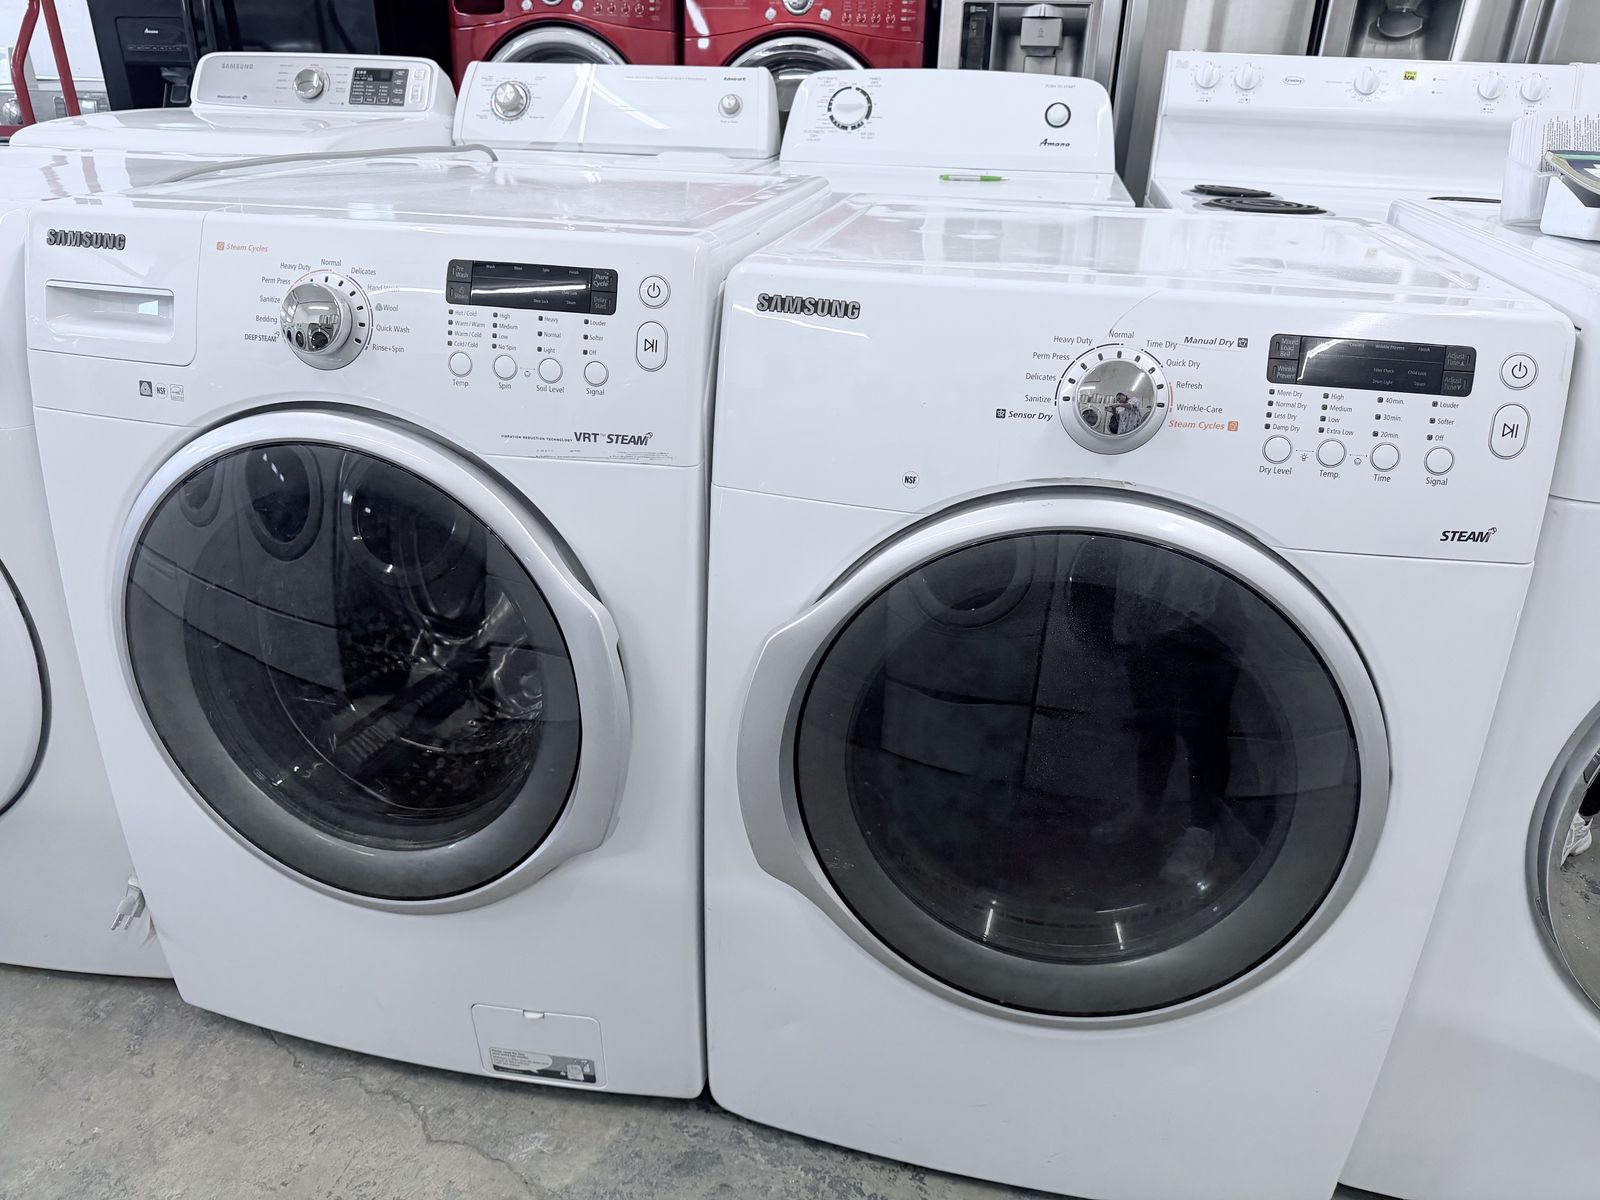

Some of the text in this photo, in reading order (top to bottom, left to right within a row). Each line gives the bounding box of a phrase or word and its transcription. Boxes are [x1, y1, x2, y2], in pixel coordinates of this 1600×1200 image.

[1039, 138, 1071, 147] Amana
[46, 228, 126, 251] SAMSUNG
[226, 243, 268, 253] Steam Cycles
[280, 262, 312, 272] Heavy Duty
[351, 267, 376, 275] Delicates
[262, 276, 275, 284] Perm
[757, 293, 861, 319] SAMSUNG
[256, 315, 278, 324] Bedding
[1109, 331, 1135, 339] Normal
[1053, 336, 1093, 345] Heavy Duty
[1147, 340, 1178, 350] Time Dry
[1184, 336, 1235, 347] Manual Dry
[1166, 359, 1201, 369] Quick Dry
[1026, 372, 1056, 381] Delicates
[498, 382, 511, 390] Spin
[1176, 381, 1203, 390] Refresh
[586, 388, 605, 396] Signal
[1293, 390, 1303, 399] Dry
[1025, 395, 1051, 403] Sanitize
[1331, 393, 1344, 401] High
[1176, 404, 1223, 414] Wrinkle-Care
[1297, 402, 1307, 410] Dry
[1440, 401, 1459, 409] Louder
[1008, 411, 1053, 422] Sensor Dry
[1287, 413, 1297, 421] Dry
[1168, 419, 1225, 431] Steam Cycles
[1290, 425, 1300, 433] Dry
[606, 433, 649, 446] STEAM
[1259, 466, 1292, 475] Dry Level
[1319, 470, 1340, 479] Temp.
[905, 476, 916, 484] NSF
[1374, 474, 1391, 482] Time
[1425, 477, 1448, 487] Signal
[1440, 530, 1491, 543] STEAM
